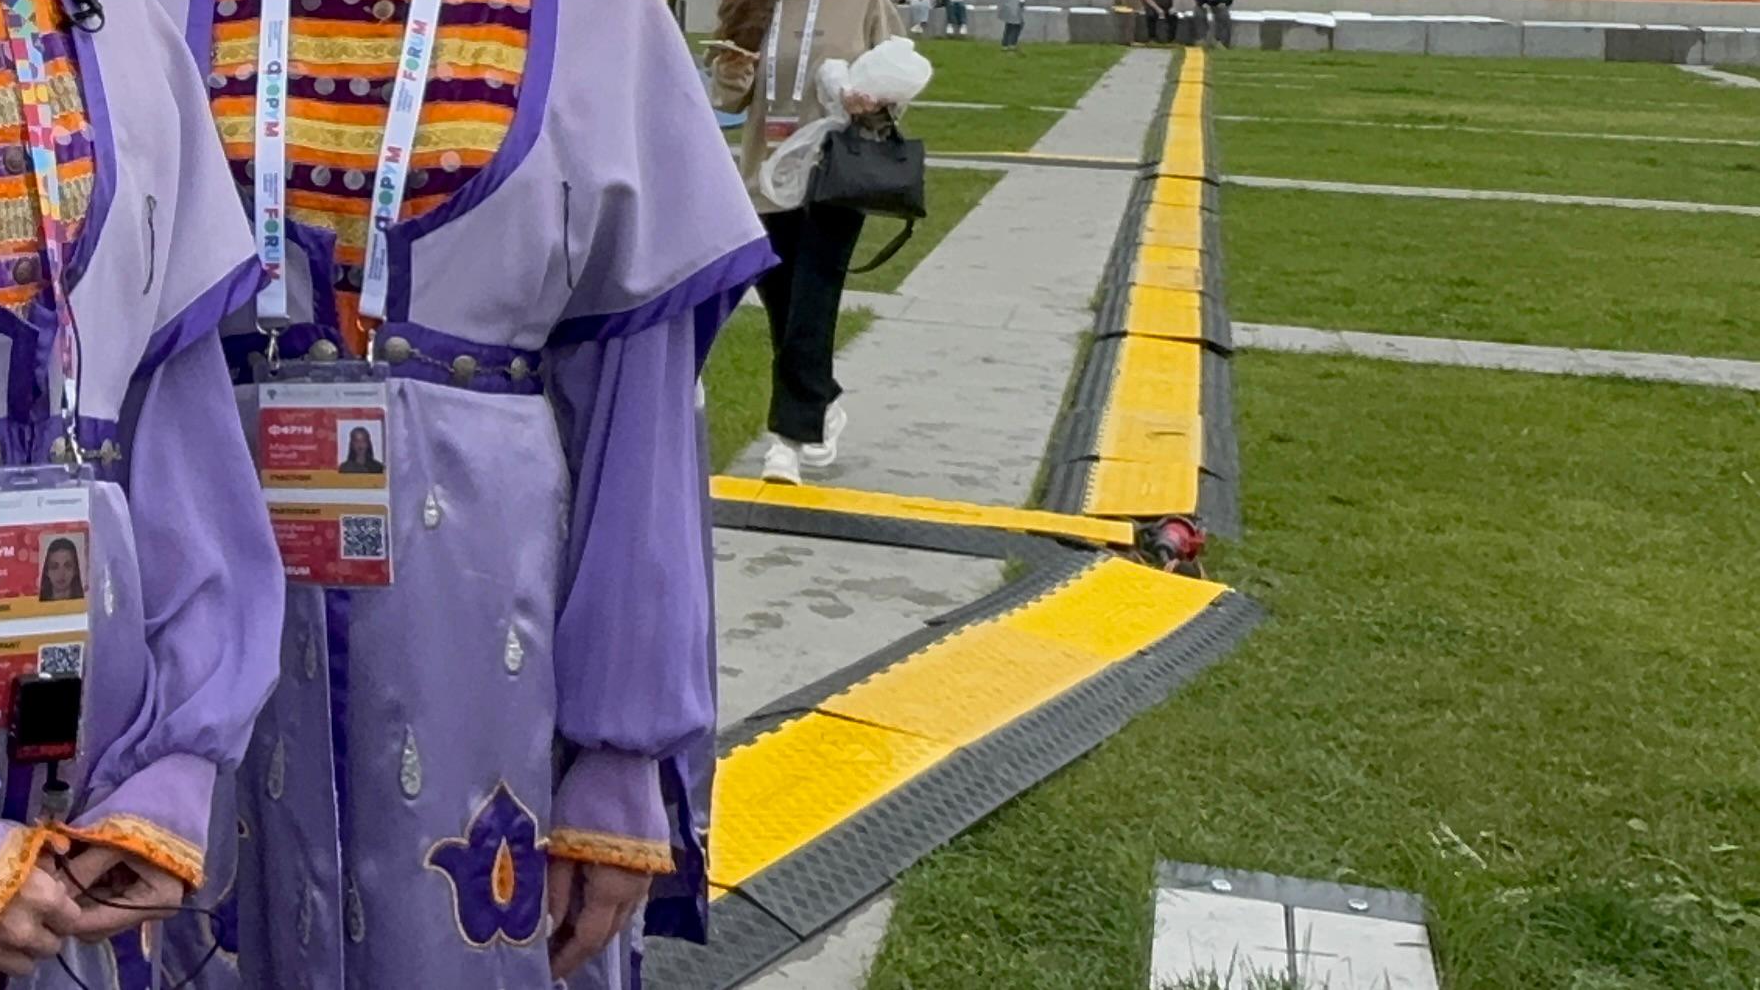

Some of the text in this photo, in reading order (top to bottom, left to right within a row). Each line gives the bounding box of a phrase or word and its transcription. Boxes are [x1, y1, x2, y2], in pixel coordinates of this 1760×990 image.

[403, 19, 428, 81] FORUM
[264, 60, 283, 138] ФОРУМ
[375, 145, 403, 232] ФОРУМ
[263, 207, 281, 281] FORUM
